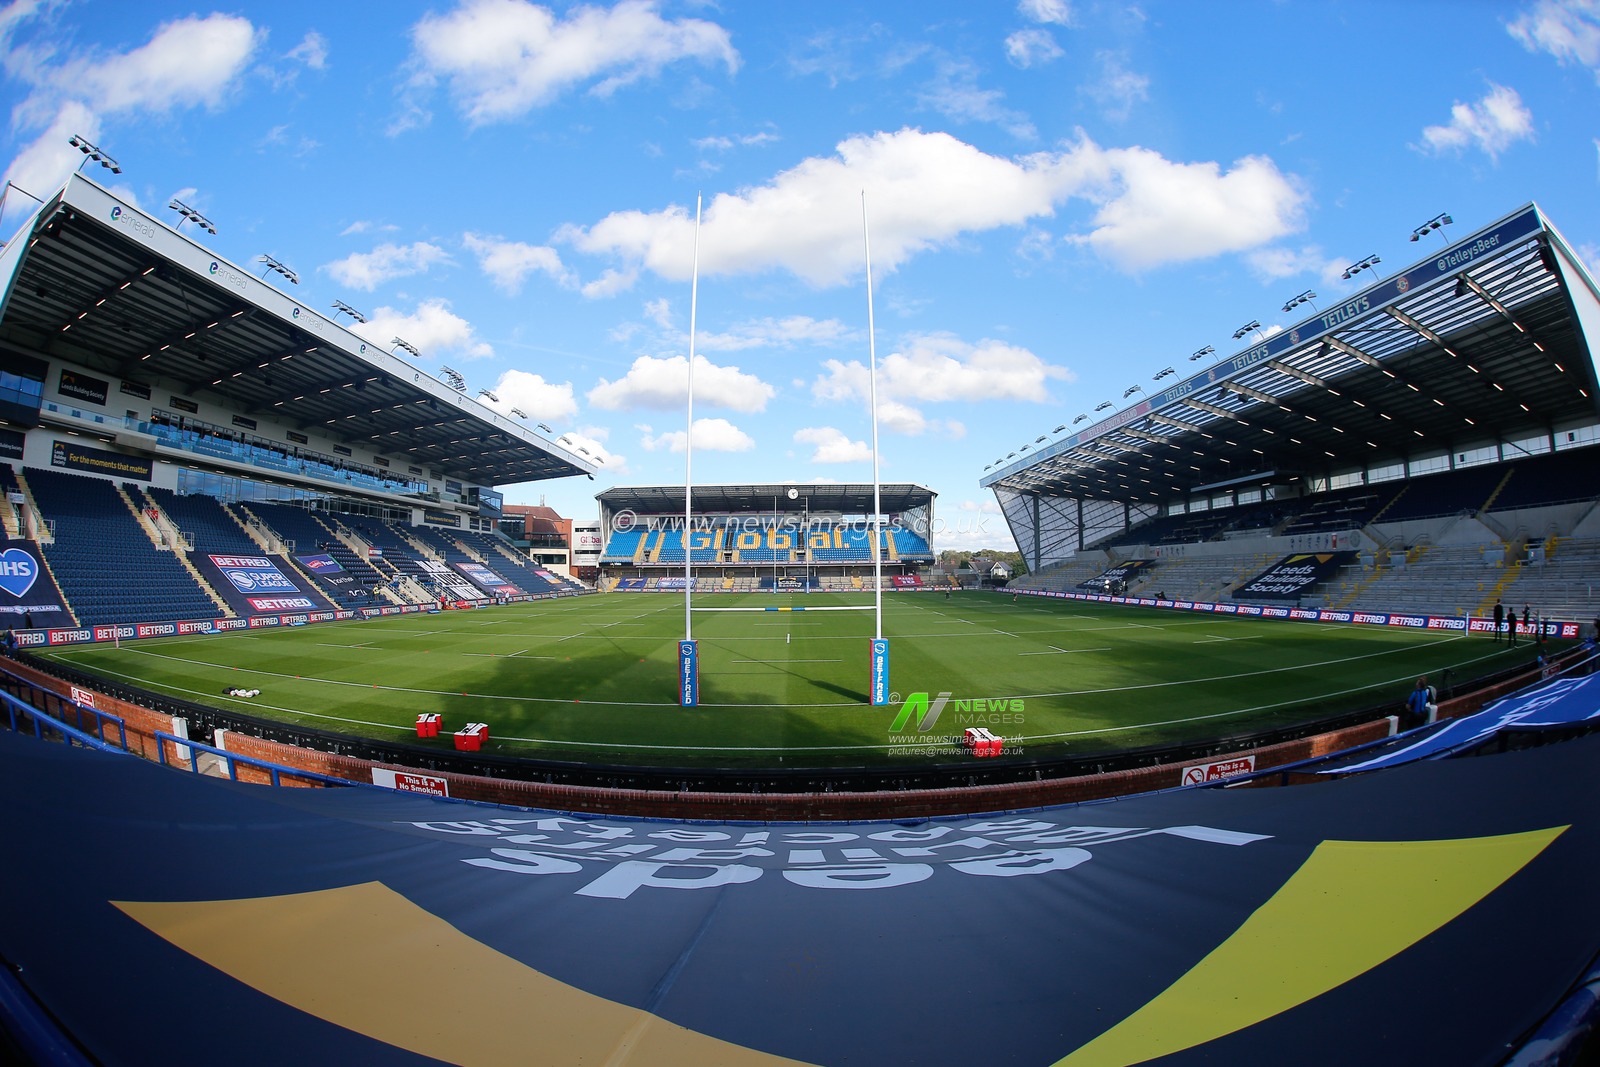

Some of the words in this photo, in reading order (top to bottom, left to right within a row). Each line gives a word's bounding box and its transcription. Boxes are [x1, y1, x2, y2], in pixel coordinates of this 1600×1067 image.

[121, 212, 155, 238] emerald
[1437, 233, 1500, 271] @TetleysBeer
[218, 268, 248, 290] emerald
[1321, 296, 1370, 329] TETLEY'S
[74, 385, 90, 397] Building
[90, 390, 104, 400] Society
[70, 453, 80, 462] For
[80, 456, 90, 464] the
[90, 458, 117, 468] moments
[118, 461, 129, 470] that
[130, 463, 148, 474] matter
[216, 558, 270, 567] BETFRED
[1271, 564, 1316, 574] Leeds
[250, 572, 284, 580] SUPER
[1258, 574, 1316, 585] Building
[1244, 583, 1301, 594] Society
[252, 598, 312, 609] BETFRED
[1214, 604, 1236, 612] BETFRED
[1238, 606, 1260, 614] BETFRED
[1262, 608, 1288, 616] BETFRED
[1290, 610, 1318, 618] BETFRED
[1320, 612, 1350, 621] BETFRED
[1353, 614, 1386, 624] BETFRED
[1389, 616, 1424, 626] BETFRED
[1428, 618, 1466, 629] BETFRED
[16, 633, 45, 644] TFRED
[52, 630, 91, 643] BETFRED
[140, 624, 174, 636] BETFRED
[180, 622, 212, 632] BETFRED
[216, 620, 246, 629] BETFRED
[251, 617, 278, 626] BETFRED
[282, 614, 308, 624] BETFRED
[310, 612, 334, 621] BETFRED
[876, 656, 884, 703] BETFRED
[1216, 764, 1231, 772] This
[404, 776, 420, 785] This
[422, 777, 428, 786] is
[400, 782, 409, 790] No
[410, 784, 442, 796] Smoking
